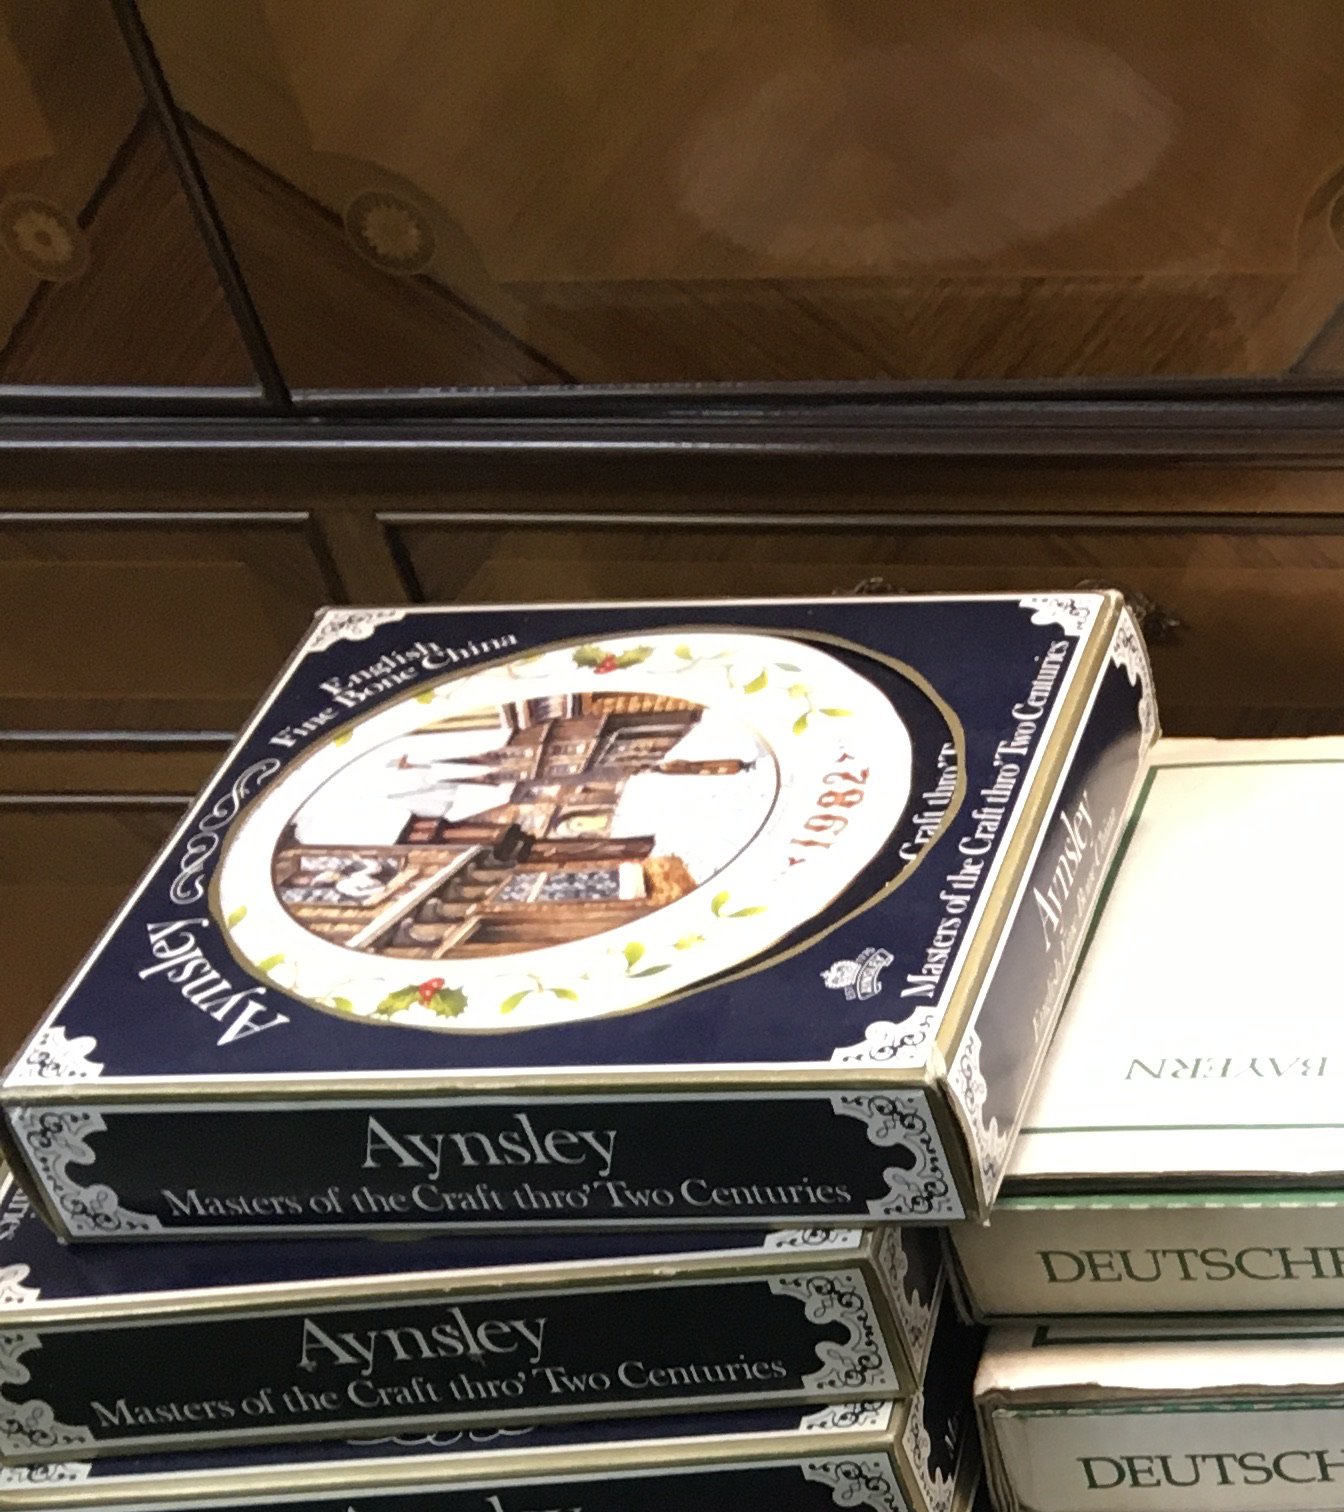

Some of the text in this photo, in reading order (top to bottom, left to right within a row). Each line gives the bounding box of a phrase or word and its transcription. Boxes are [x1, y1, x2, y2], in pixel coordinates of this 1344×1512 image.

[268, 633, 518, 748] Fine Bone China
[319, 641, 444, 696] English
[1011, 639, 1070, 721] Centuries
[995, 721, 1037, 757] Two
[790, 764, 870, 850] 1982
[958, 806, 1006, 855] Craft
[939, 889, 971, 914] of
[945, 857, 985, 890] the
[1033, 789, 1092, 952] Aynsley
[138, 915, 291, 1046] Aynsley
[900, 916, 963, 998] Masters
[361, 1114, 618, 1180] Aynsley
[162, 1176, 852, 1217] Masters of the Craft thro' Two Centuries
[296, 1306, 548, 1375] Aynsley
[91, 1354, 788, 1429] Masters of the Craft thro' Two Centuries
